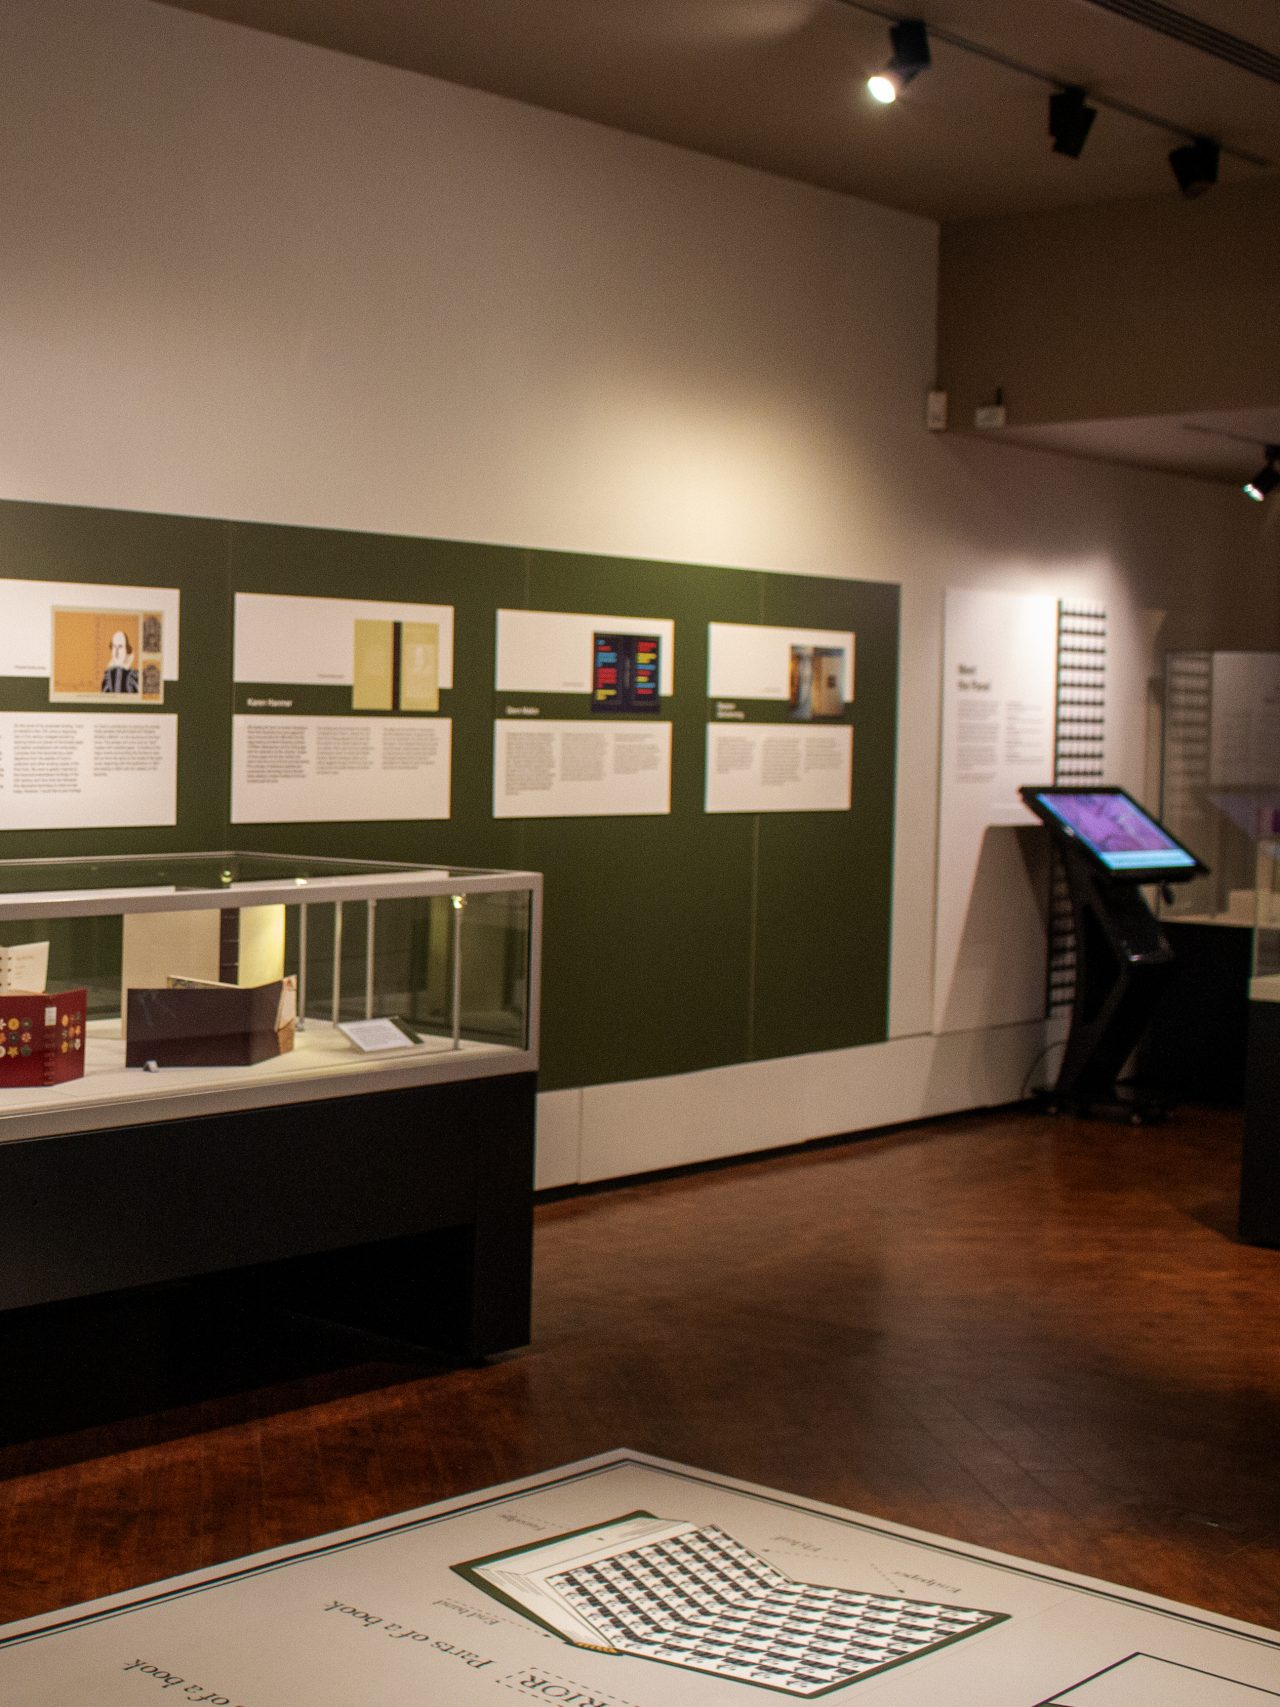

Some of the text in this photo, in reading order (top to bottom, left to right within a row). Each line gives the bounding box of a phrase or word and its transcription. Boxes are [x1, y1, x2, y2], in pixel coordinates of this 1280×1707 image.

[324, 1600, 496, 1670] Parts of a book
[123, 1658, 230, 1706] of a book
